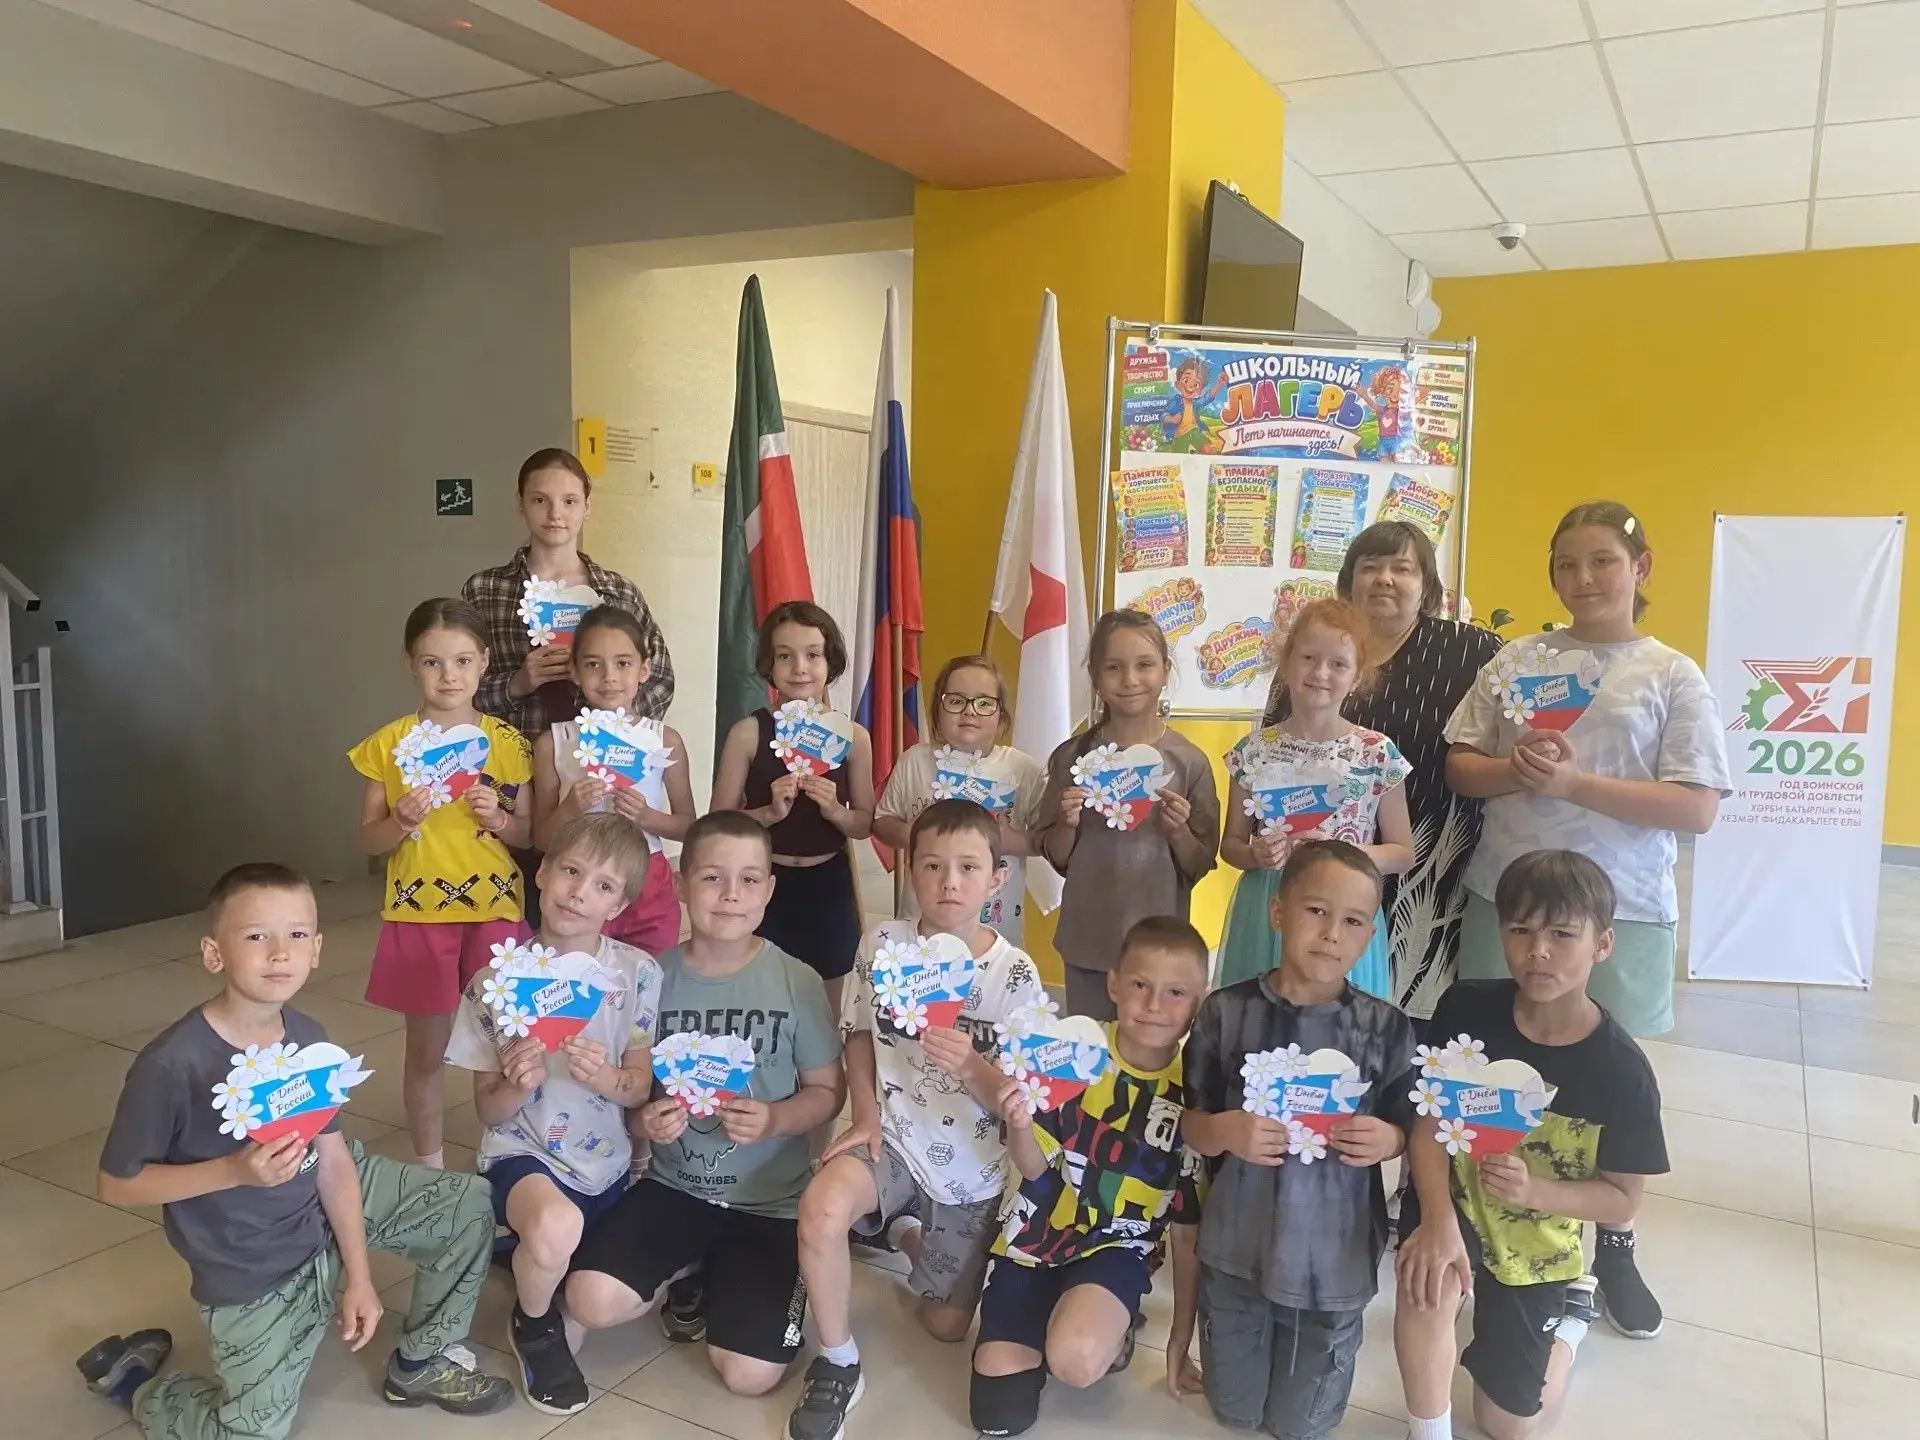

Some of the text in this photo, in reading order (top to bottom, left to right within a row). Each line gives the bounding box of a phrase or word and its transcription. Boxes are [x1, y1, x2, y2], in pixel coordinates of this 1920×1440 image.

[1129, 356, 1157, 366] ДРУЖБА
[1126, 371, 1163, 381] ТВОРЧЕСТВО
[1224, 356, 1361, 388] ШКОЛЬНЫЙ
[1133, 386, 1156, 395] СПОРТ
[1126, 400, 1167, 410] ПРИКЛЮЧЕНИЯ
[1221, 379, 1365, 429] ЛАГЕРЬ
[1134, 413, 1160, 424] ОТДЫХ
[1268, 426, 1331, 440] начинается
[589, 437, 596, 454] 1
[1306, 435, 1345, 455] здесь!
[1123, 468, 1169, 482] Памятка
[1225, 468, 1265, 477] ПРАВИЛА
[1314, 470, 1328, 480] Что
[1128, 477, 1167, 488] хорошего
[1218, 476, 1272, 487] БЕЗОПАСНОГО
[1225, 485, 1264, 493] ОТДЫХА
[1407, 481, 1439, 499] Добро
[1145, 587, 1172, 612] Ура!
[1154, 600, 1195, 623] никулы
[1162, 611, 1196, 633] ались!
[1539, 691, 1568, 706] России
[1746, 739, 1865, 777] 2026
[1779, 779, 1864, 791] ГОД ВОИНСКОЙ
[1738, 788, 1863, 802] И ТРУДОВОЙ ДОБЛЕСТИ
[1750, 804, 1783, 813] ХӘРБИ
[1785, 805, 1837, 815] БАТЫРЛЫК
[1720, 814, 1862, 827] ХЕЗМӘТ ФИДАКАРЬЛЕГЕ ЕЛЫ
[445, 882, 472, 904] DREAM
[904, 969, 939, 988] С Днём
[533, 980, 568, 1004] С Днём
[911, 982, 941, 999] России
[541, 993, 573, 1014] России
[658, 1008, 789, 1055] ERFECT
[696, 1059, 704, 1068] С
[695, 1070, 726, 1084] России
[268, 1077, 309, 1105] С Днём
[1458, 1088, 1499, 1102] С Днём
[276, 1091, 313, 1115] России
[1465, 1104, 1501, 1115] России
[677, 1170, 702, 1184] GOOD
